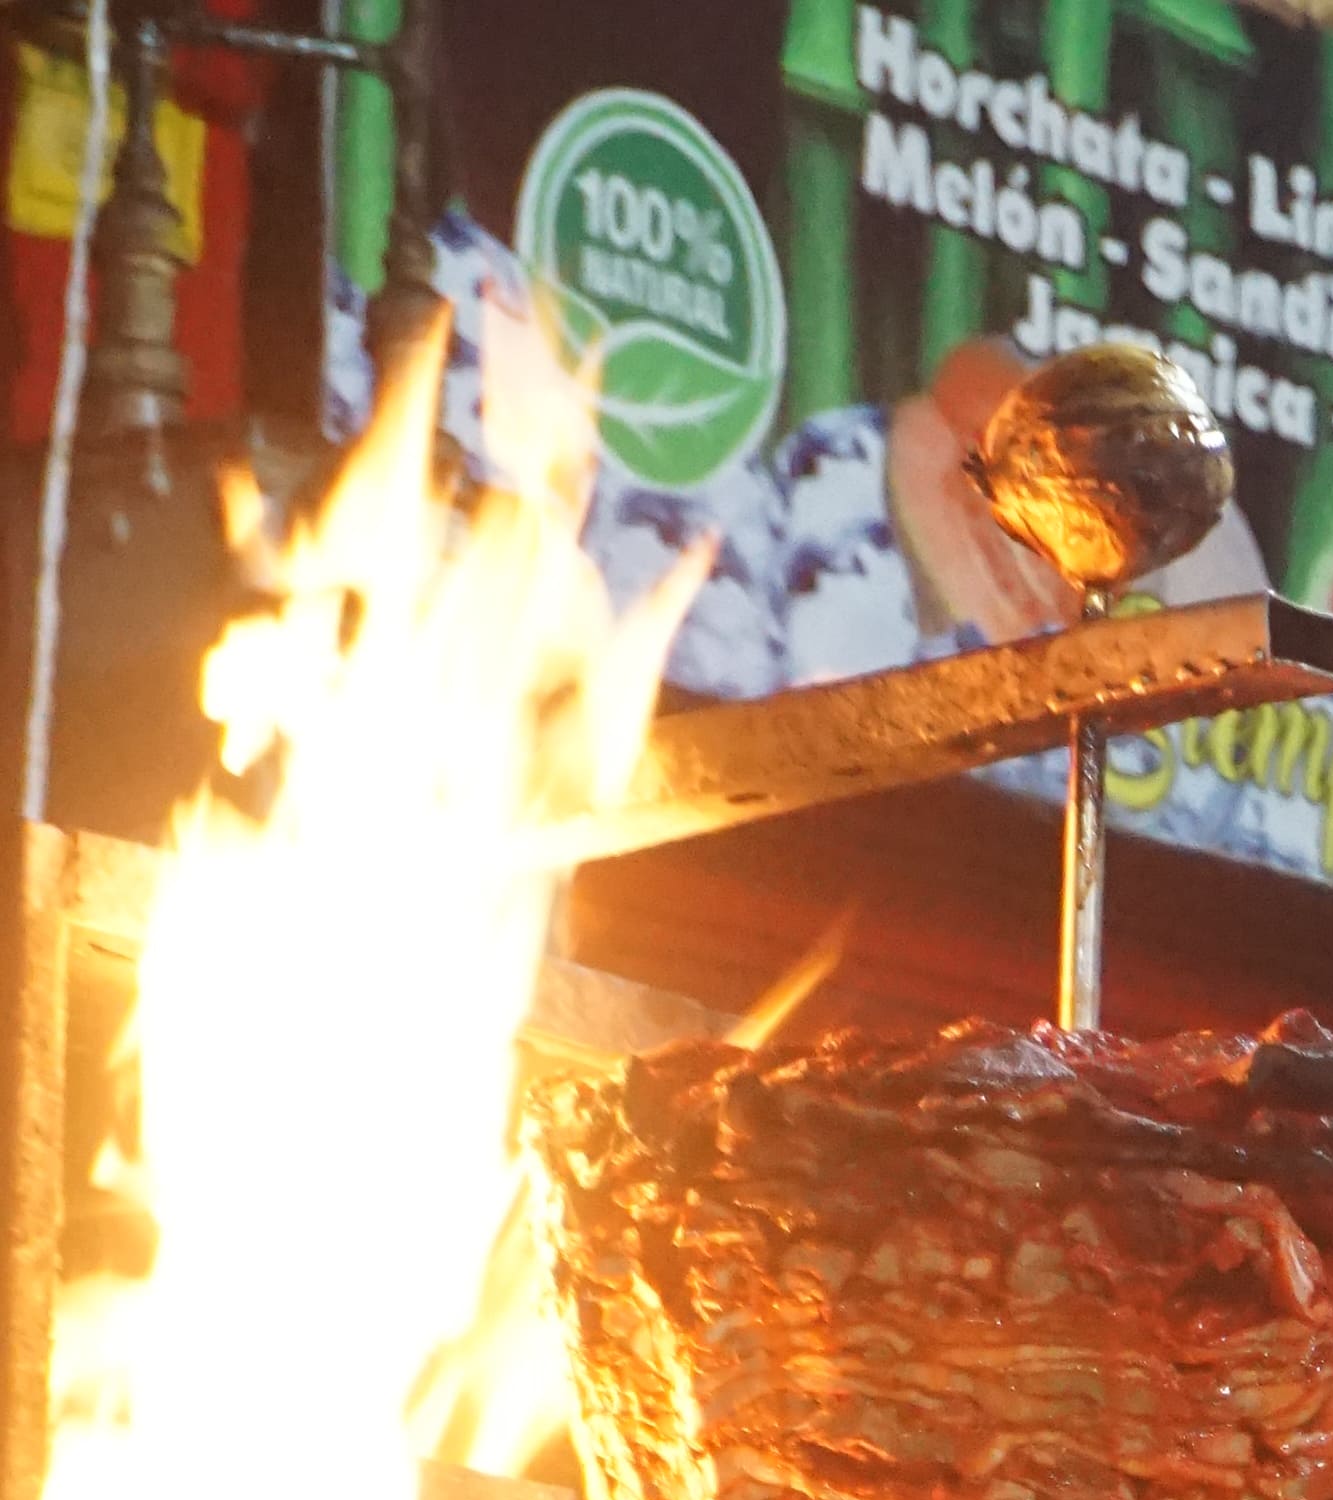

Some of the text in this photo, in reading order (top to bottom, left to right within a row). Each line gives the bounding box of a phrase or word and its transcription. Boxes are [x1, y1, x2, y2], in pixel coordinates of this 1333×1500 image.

[857, 4, 1189, 207] Horchata
[575, 168, 733, 288] 100%
[863, 110, 1084, 269] Melón
